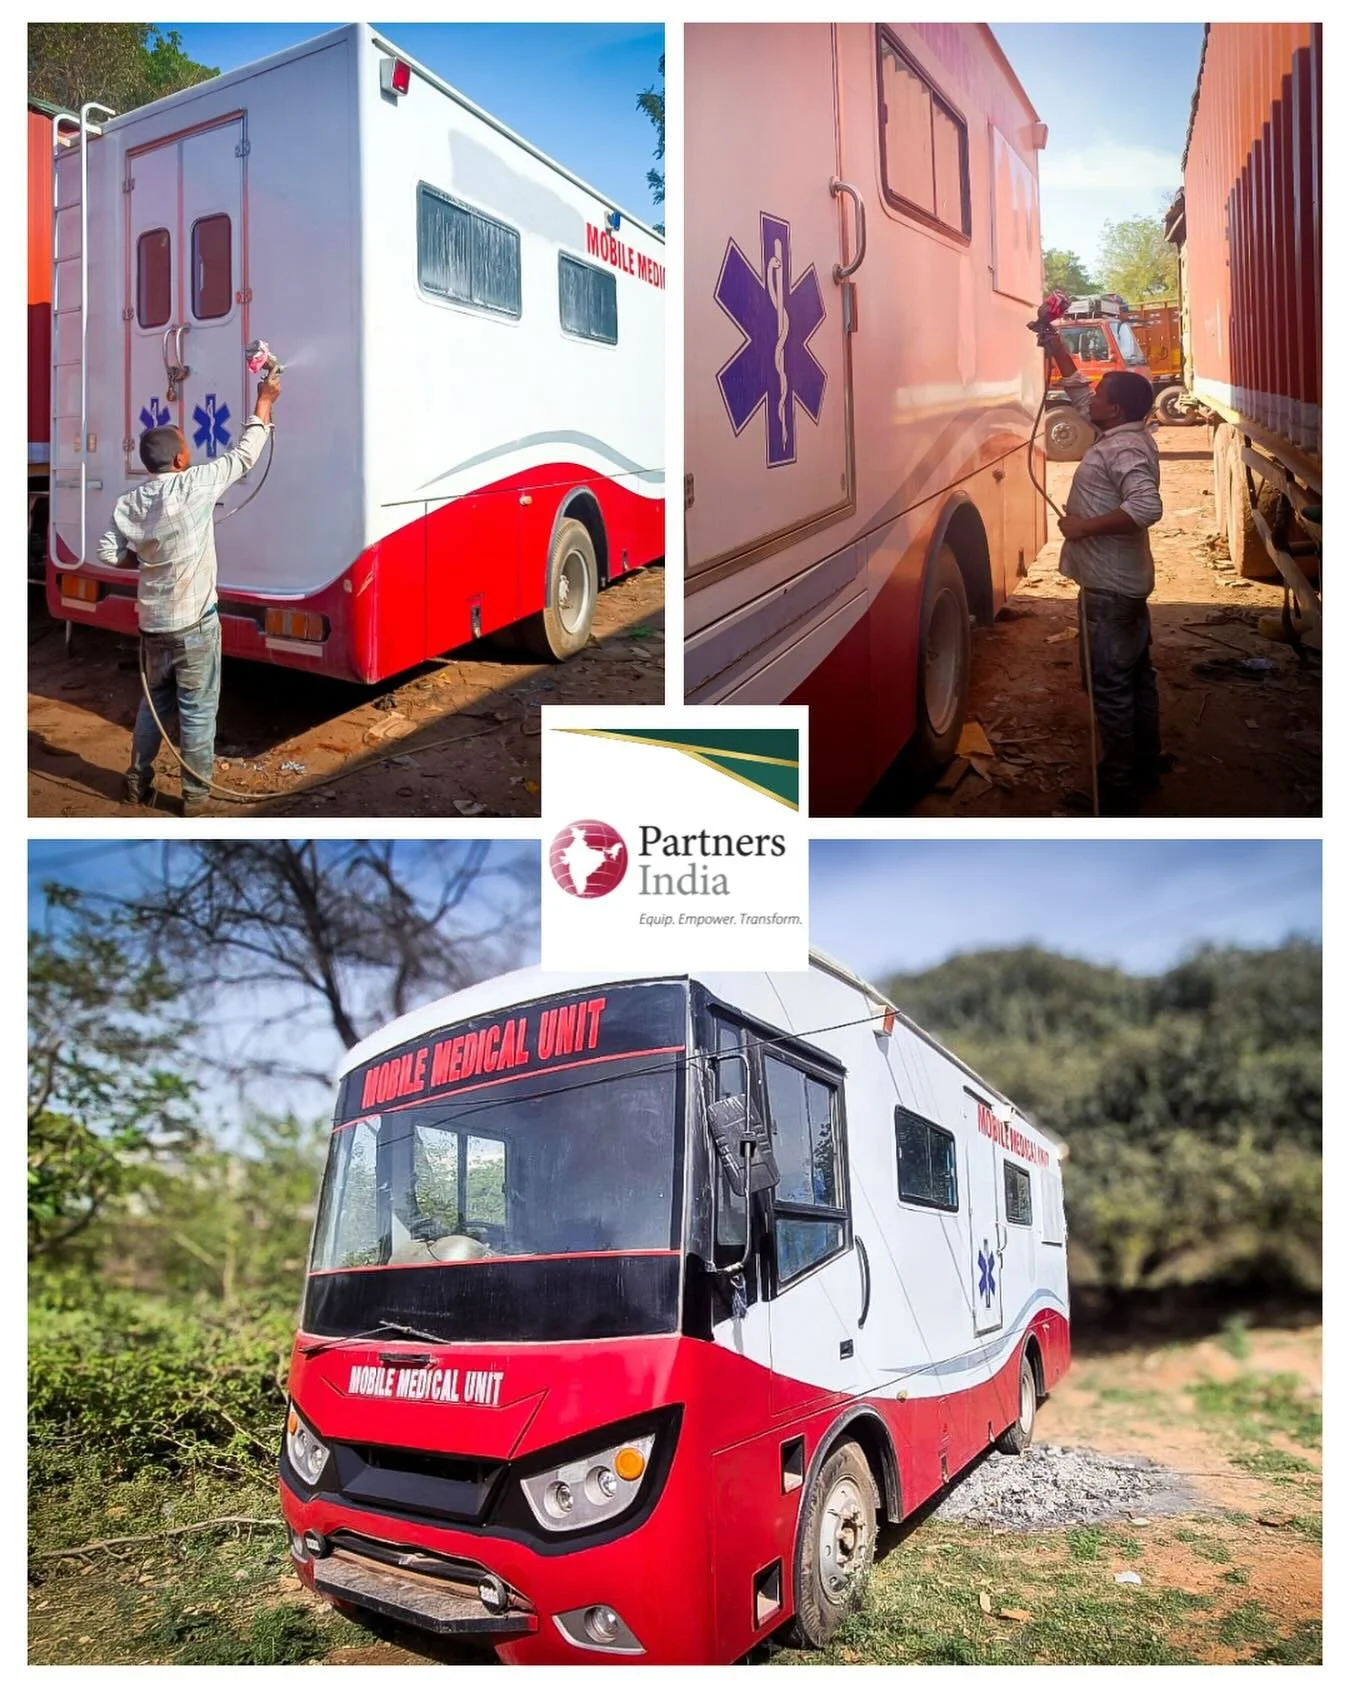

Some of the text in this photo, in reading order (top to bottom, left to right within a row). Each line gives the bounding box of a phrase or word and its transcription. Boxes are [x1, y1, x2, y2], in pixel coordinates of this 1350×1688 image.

[586, 222, 665, 290] MOBILE MEDI
[361, 997, 607, 1110] MOBILE MEDICAL UNIT
[977, 1102, 1010, 1151] MOBILE
[348, 1365, 504, 1406] MOBILE MEDICAL UNIT
